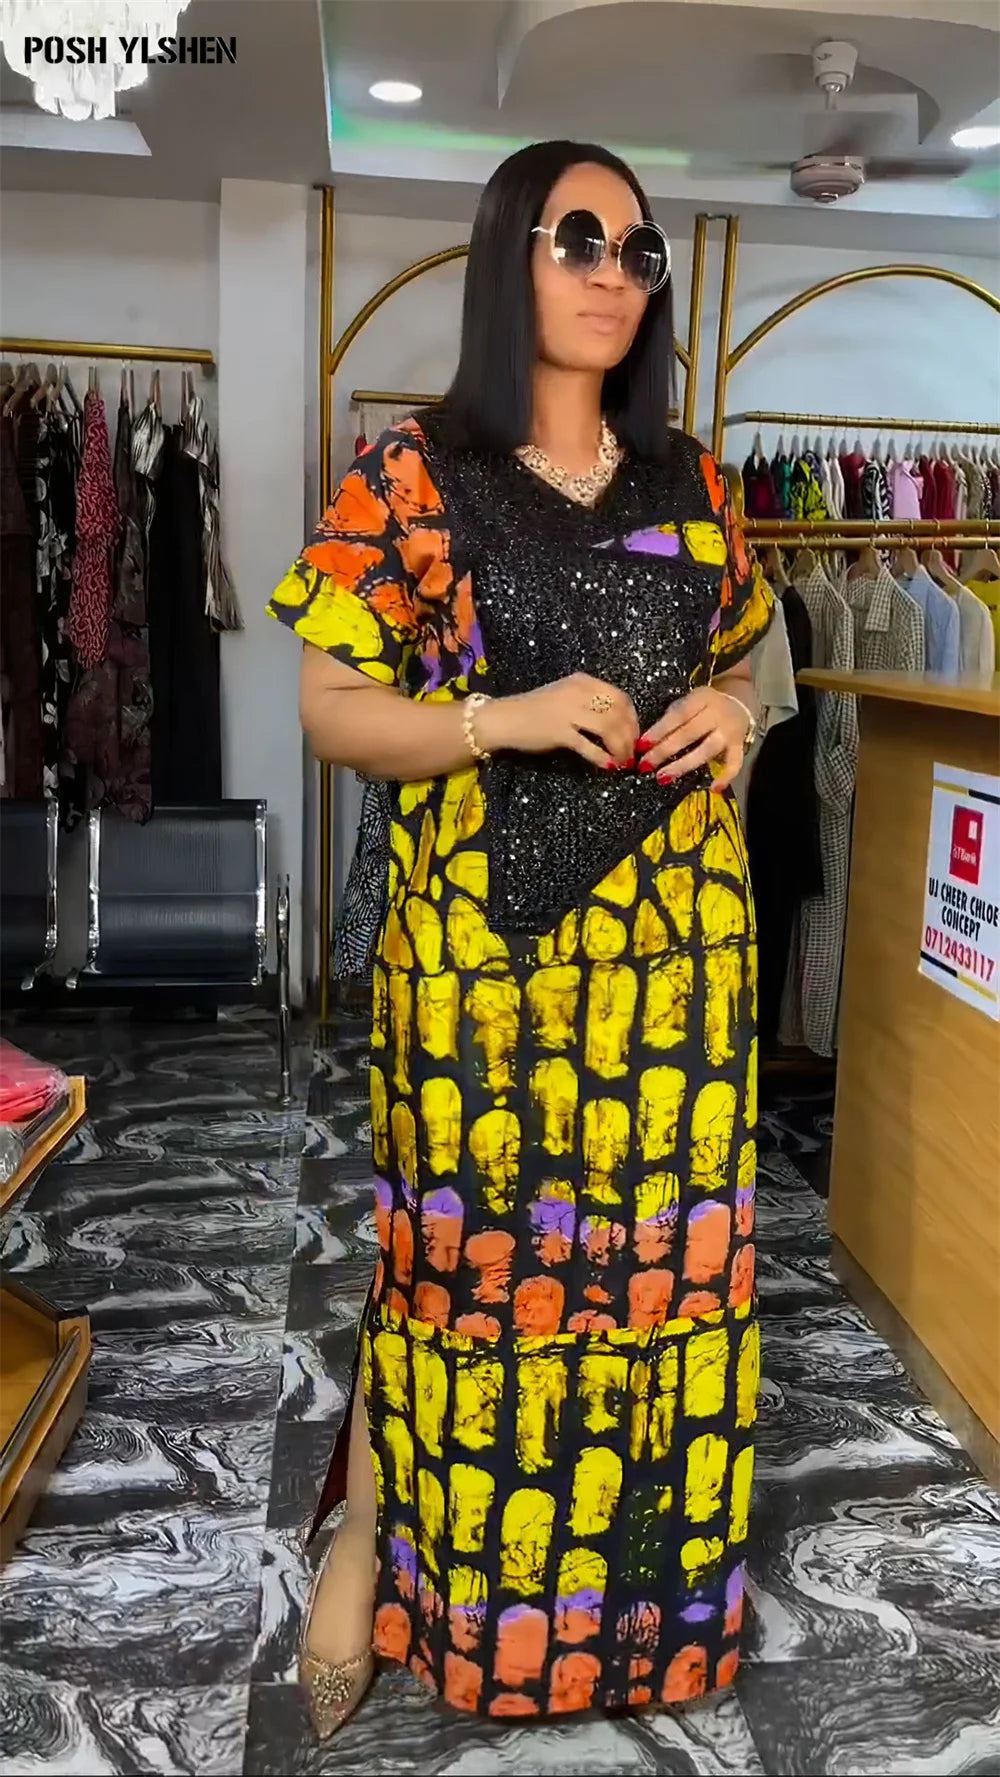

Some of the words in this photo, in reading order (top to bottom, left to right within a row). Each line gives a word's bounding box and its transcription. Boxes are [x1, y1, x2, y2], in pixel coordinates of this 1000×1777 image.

[928, 877, 939, 898] UJ
[940, 882, 968, 912] CHEER
[969, 896, 1000, 927] CHLOE
[941, 905, 981, 942] CONCEPT
[925, 925, 995, 982] 0712433117
